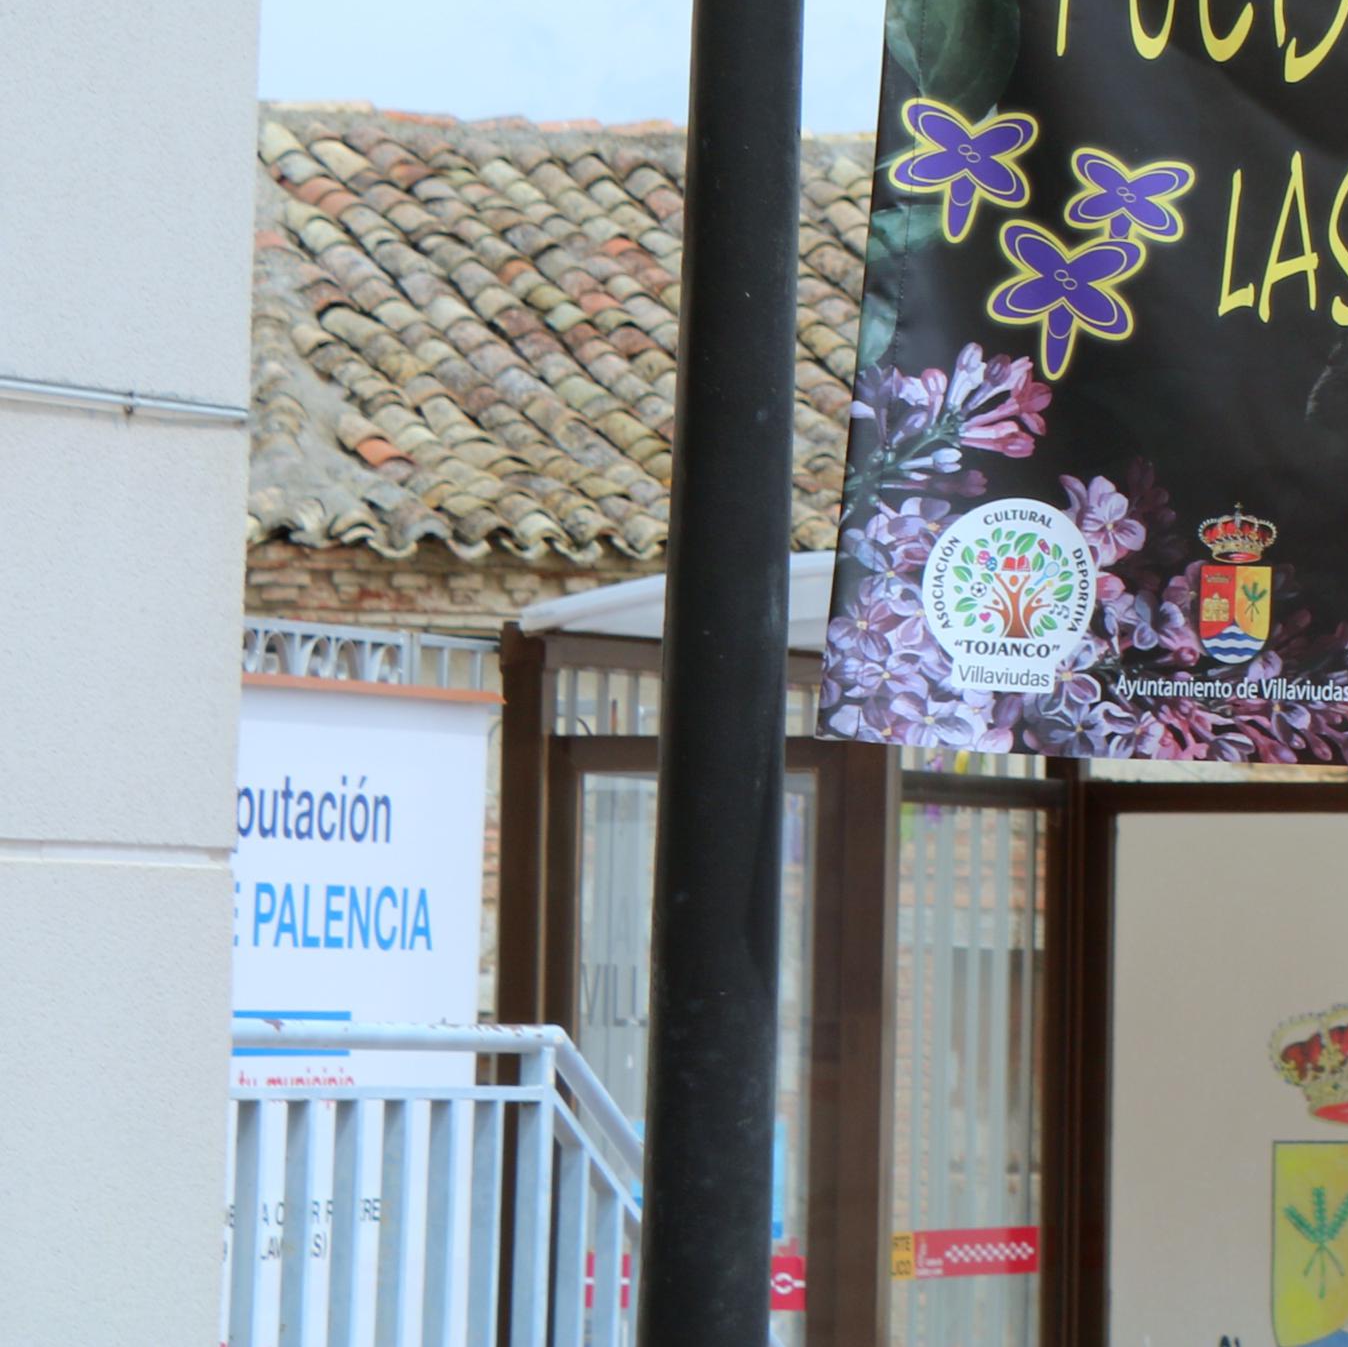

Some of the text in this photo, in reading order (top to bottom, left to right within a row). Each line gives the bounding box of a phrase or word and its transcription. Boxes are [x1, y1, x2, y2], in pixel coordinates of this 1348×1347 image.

[983, 509, 1053, 529] CULTURAL
[932, 536, 961, 630] ASOCIACIÓN
[1067, 548, 1090, 633] DEPORTIVA
[958, 664, 1050, 687] Villaviudas
[1115, 674, 1232, 700] Ayuntamiento
[1236, 678, 1258, 699] de
[236, 775, 392, 843] putación
[252, 882, 433, 951] PALENCIA
